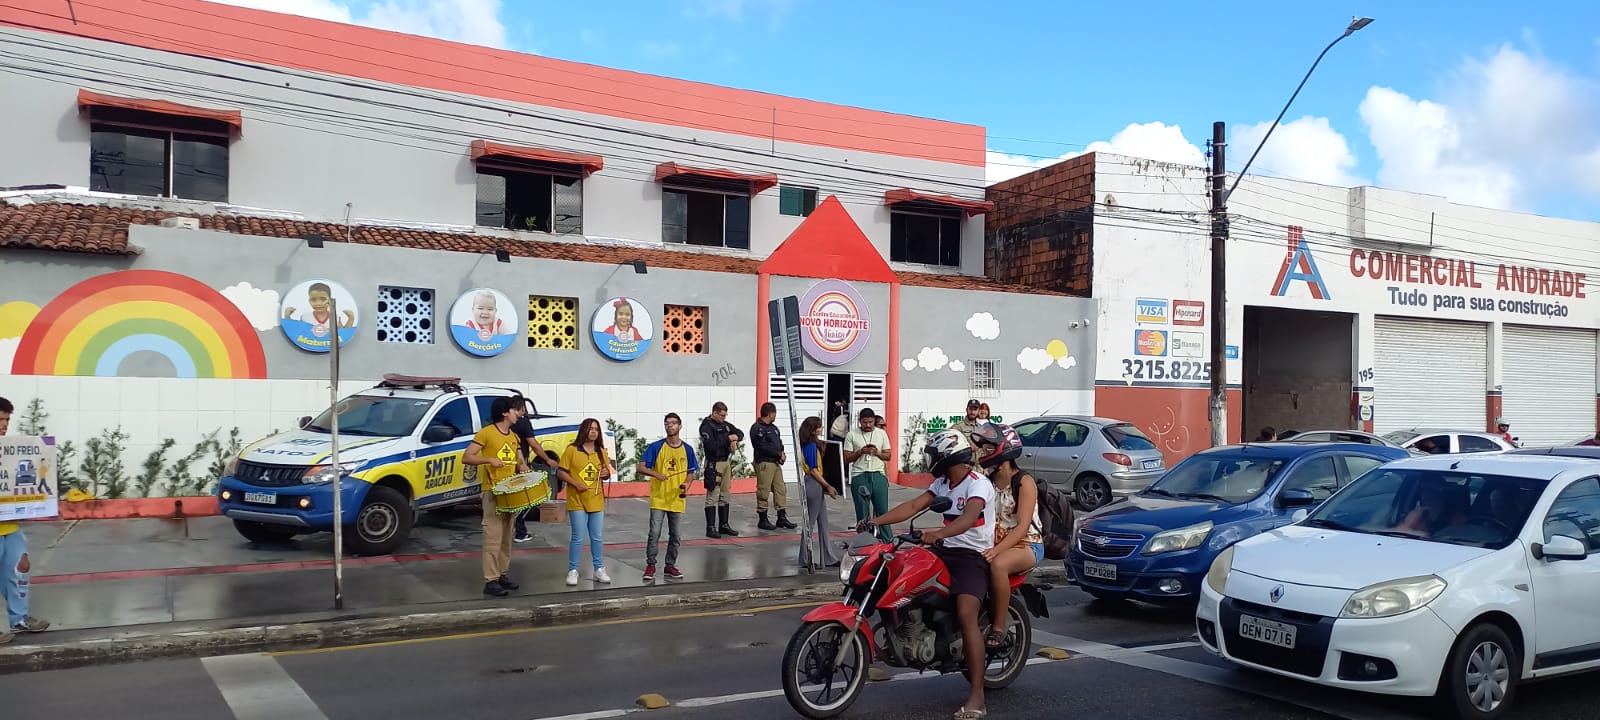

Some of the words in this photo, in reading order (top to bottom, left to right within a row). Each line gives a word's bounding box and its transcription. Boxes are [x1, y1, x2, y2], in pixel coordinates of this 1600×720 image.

[1349, 248, 1482, 289] COMERCIAL
[1496, 263, 1586, 299] ANDRADE
[1387, 286, 1428, 307] Tudo
[1433, 293, 1466, 311] para
[1470, 296, 1495, 311] sua
[1498, 299, 1569, 318] construção
[1140, 305, 1164, 316] VISA
[800, 317, 822, 327] NOVO
[823, 318, 868, 330] HORIZONTE
[1122, 358, 1212, 381] 3215.8225
[1358, 367, 1374, 382] 195
[3, 446, 15, 455] NO
[424, 455, 457, 480] SMTT
[424, 475, 453, 490] ARACAJU
